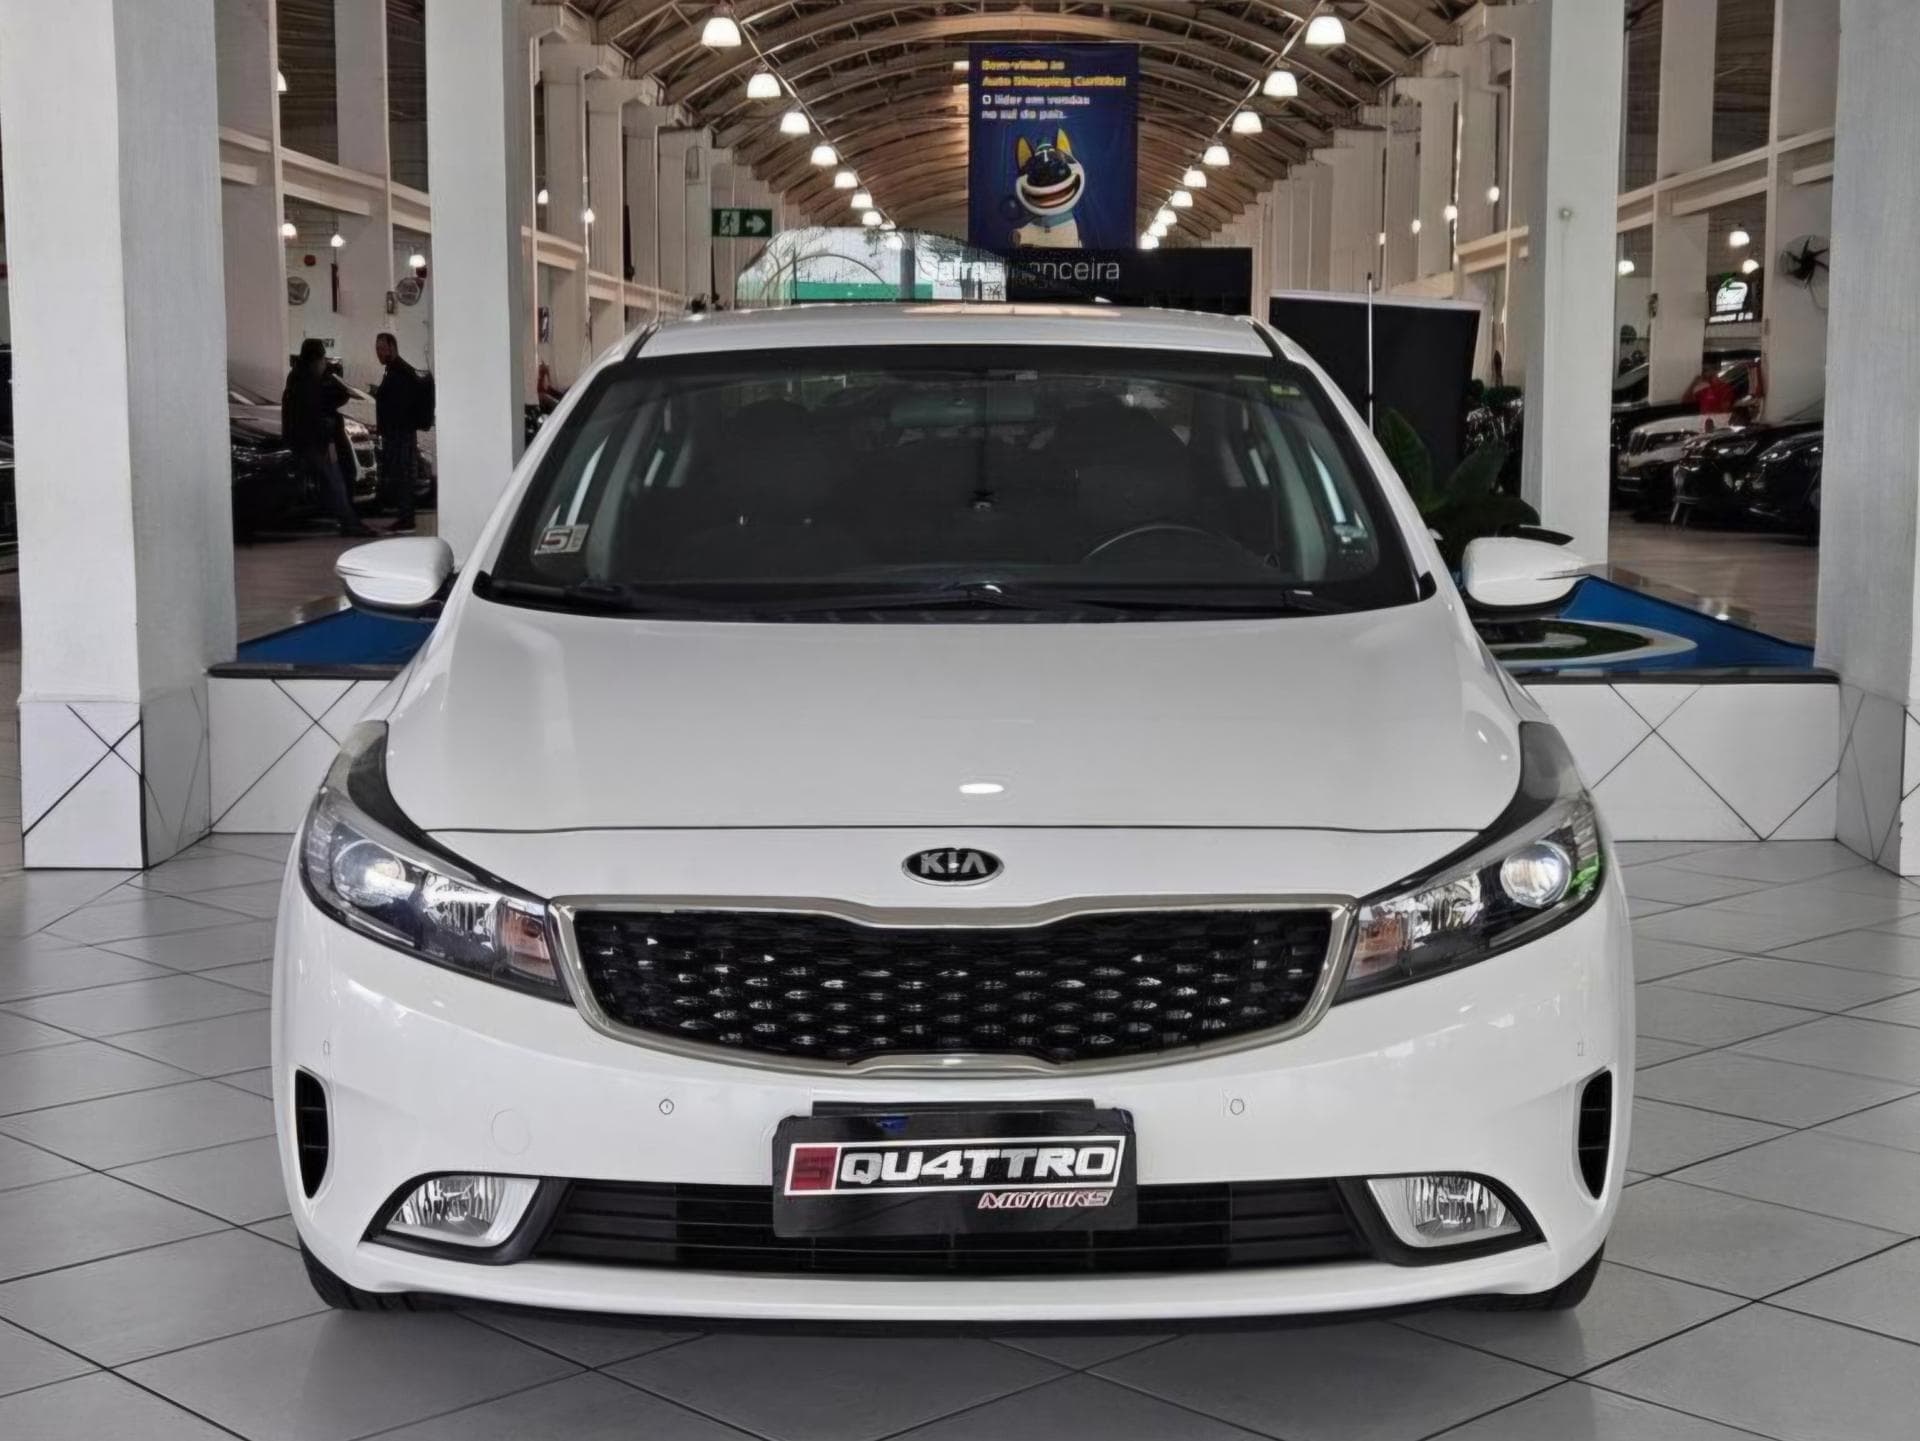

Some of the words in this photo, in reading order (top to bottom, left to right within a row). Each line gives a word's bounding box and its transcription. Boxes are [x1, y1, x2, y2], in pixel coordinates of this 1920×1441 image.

[982, 76, 1011, 87] Auto
[1012, 76, 1072, 87] Shopping
[1073, 76, 1127, 87] Curitiba!
[982, 95, 992, 105] O
[1025, 97, 1045, 105] em
[1046, 95, 1090, 105] vendas
[981, 110, 997, 119] no
[1000, 108, 1017, 119] sul
[1019, 109, 1036, 119] do
[920, 851, 988, 874] KIA
[839, 1146, 1117, 1185] QU4TTRO
[977, 1189, 1114, 1209] MOTORS
